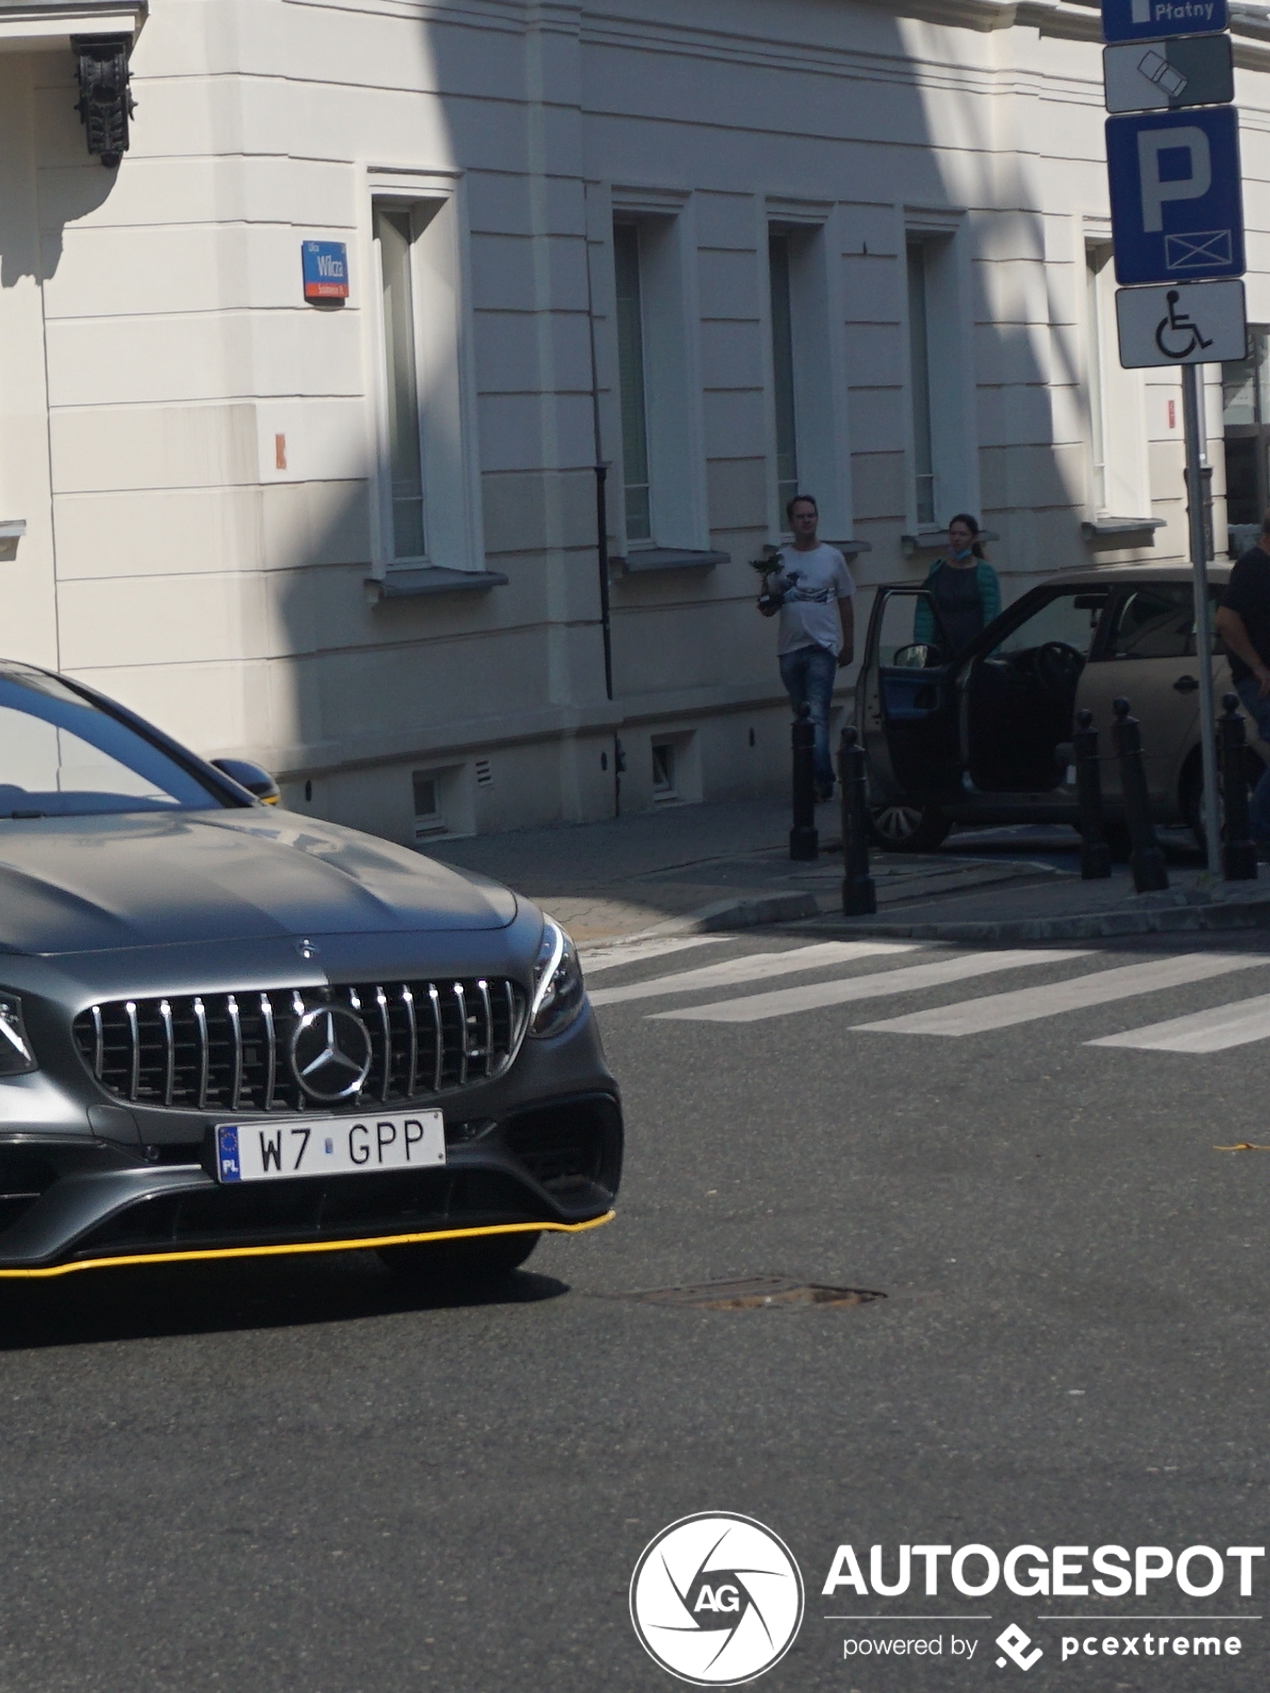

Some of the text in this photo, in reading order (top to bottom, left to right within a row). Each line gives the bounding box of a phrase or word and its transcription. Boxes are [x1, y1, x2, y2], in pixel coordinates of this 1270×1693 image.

[1155, 2, 1214, 21] Płatny
[1137, 125, 1212, 233] P
[317, 254, 344, 277] Wilcza
[258, 1119, 425, 1173] W7 GPP
[222, 1158, 239, 1174] PL
